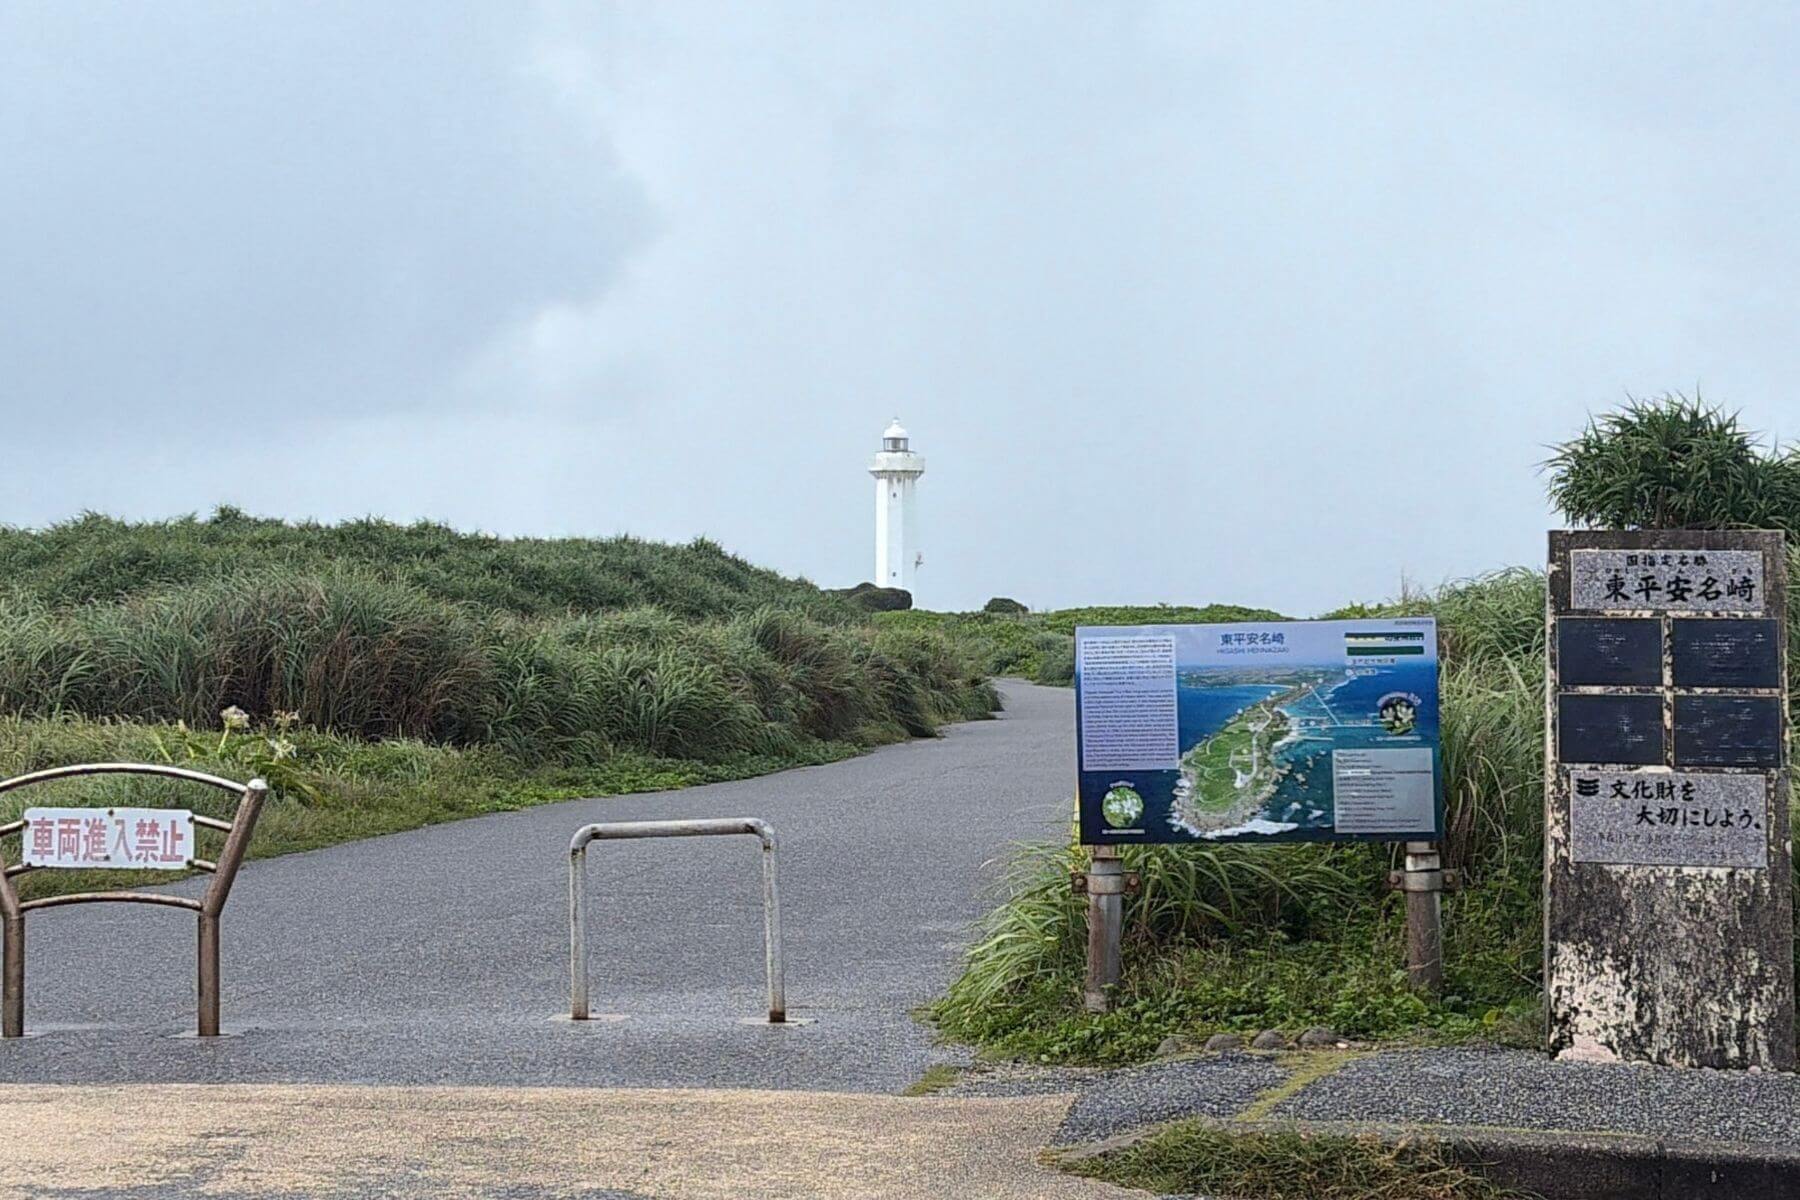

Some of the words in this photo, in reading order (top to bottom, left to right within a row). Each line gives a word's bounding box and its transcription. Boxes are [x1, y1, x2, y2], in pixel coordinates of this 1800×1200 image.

[1220, 632, 1285, 646] 東平安名崎
[1610, 780, 1696, 801] 文化財を
[31, 817, 184, 863] 車両進入禁止
